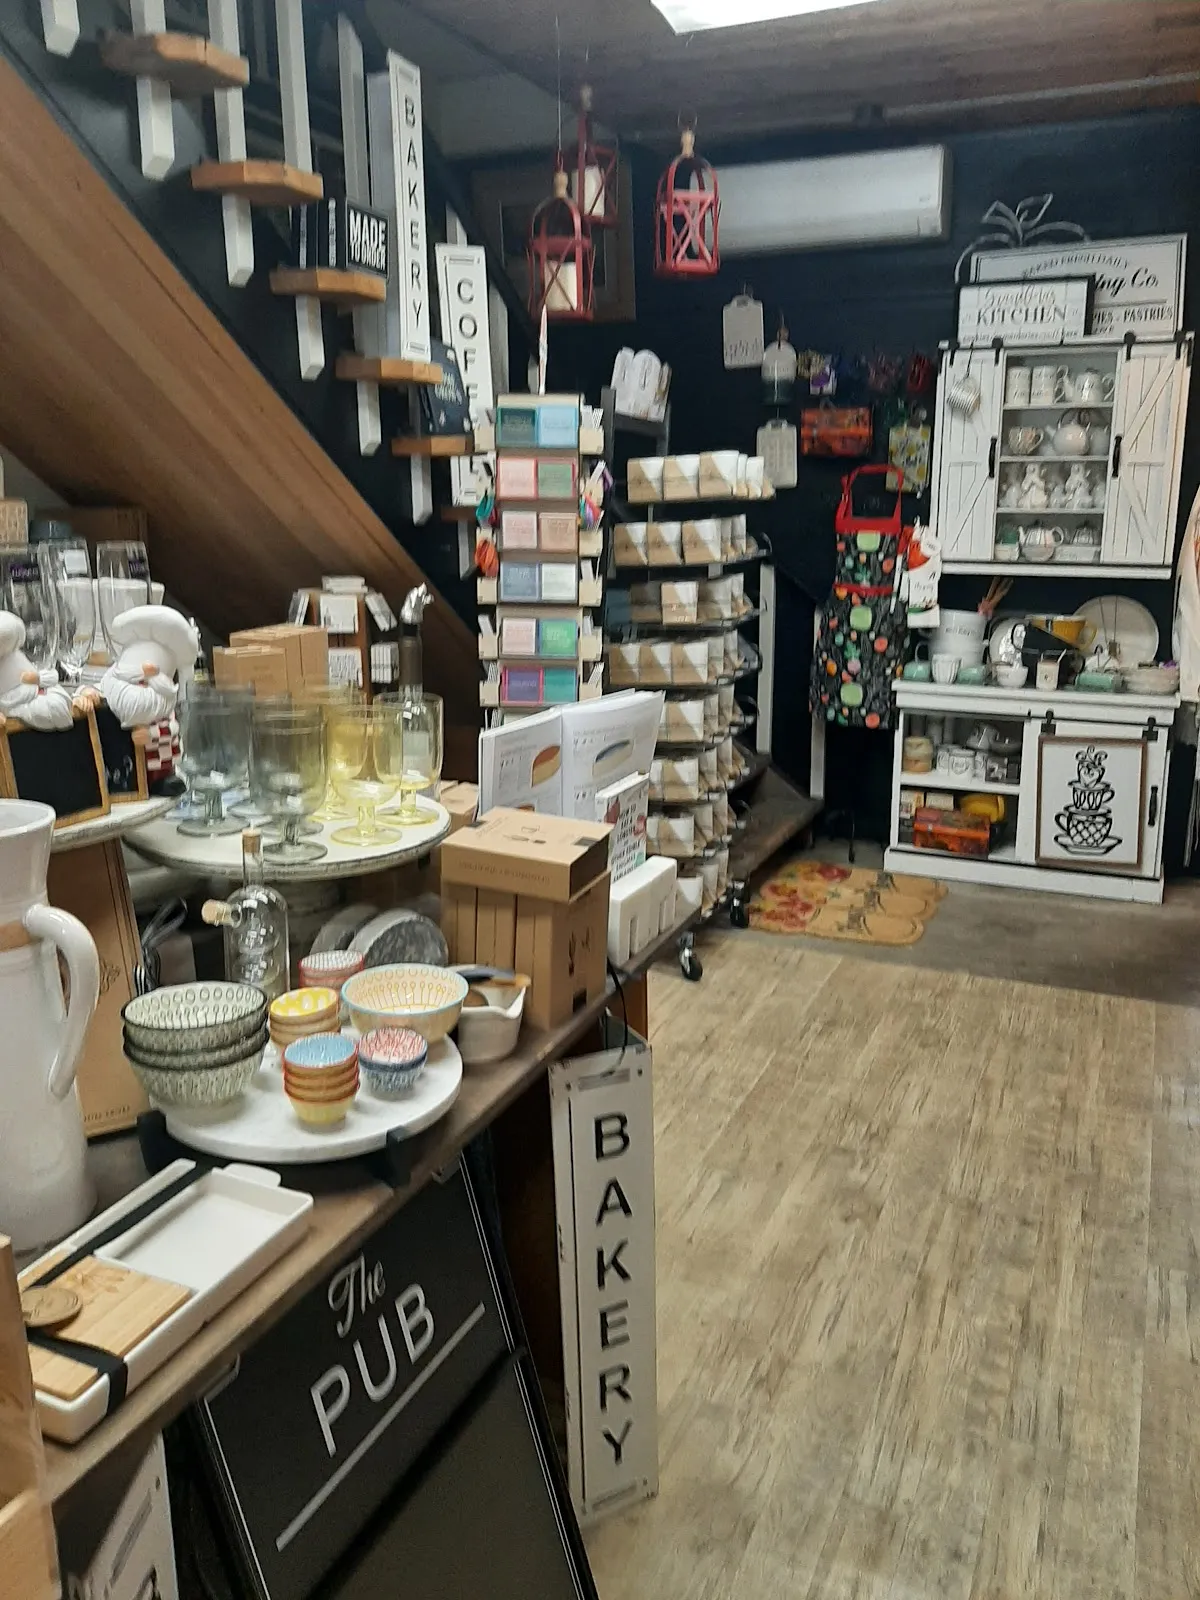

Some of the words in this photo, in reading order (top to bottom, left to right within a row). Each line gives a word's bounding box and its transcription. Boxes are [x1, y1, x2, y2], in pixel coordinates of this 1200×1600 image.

[350, 208, 386, 248] MADE
[404, 95, 423, 329] BAKERY
[361, 245, 386, 271] ORDER
[977, 305, 1067, 326] KITCHEN
[1124, 306, 1173, 323] PASTRIES
[327, 1251, 386, 1338] The
[594, 1112, 632, 1466] BAKERY
[310, 1283, 434, 1458] PUB
